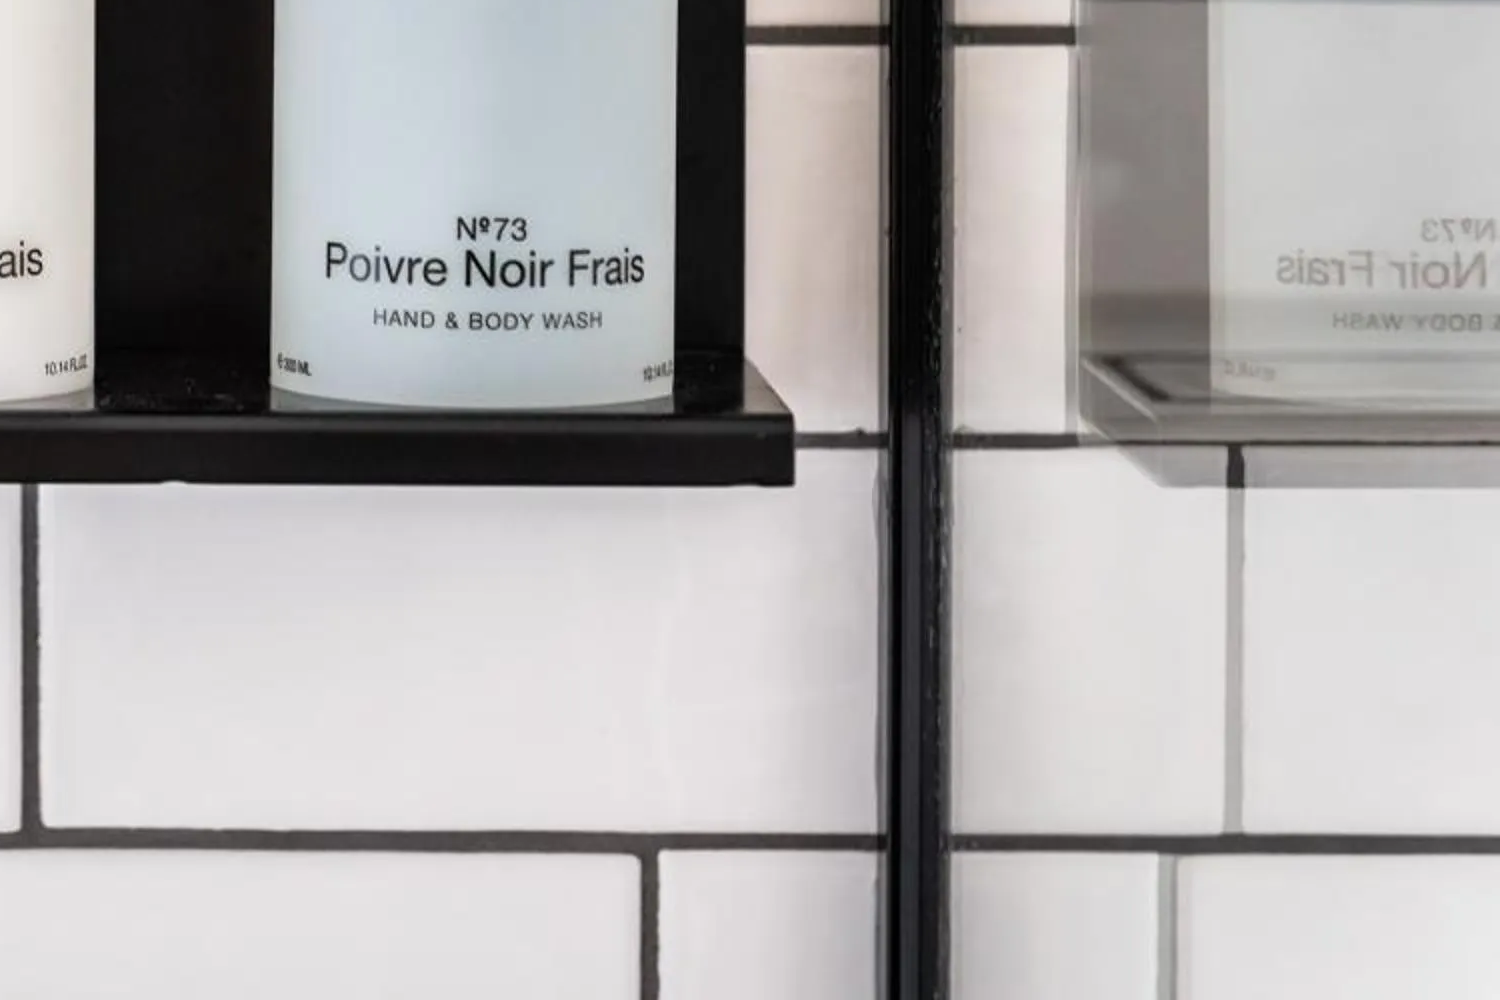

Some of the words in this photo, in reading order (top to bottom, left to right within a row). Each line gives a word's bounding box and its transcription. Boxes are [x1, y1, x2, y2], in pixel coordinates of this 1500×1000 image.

[325, 241, 449, 286] Poivre
[464, 248, 554, 289] Noir
[568, 247, 645, 287] Frais
[373, 308, 435, 330] HAND
[445, 312, 460, 330] &
[468, 311, 534, 331] BODY
[542, 311, 603, 330] WASH
